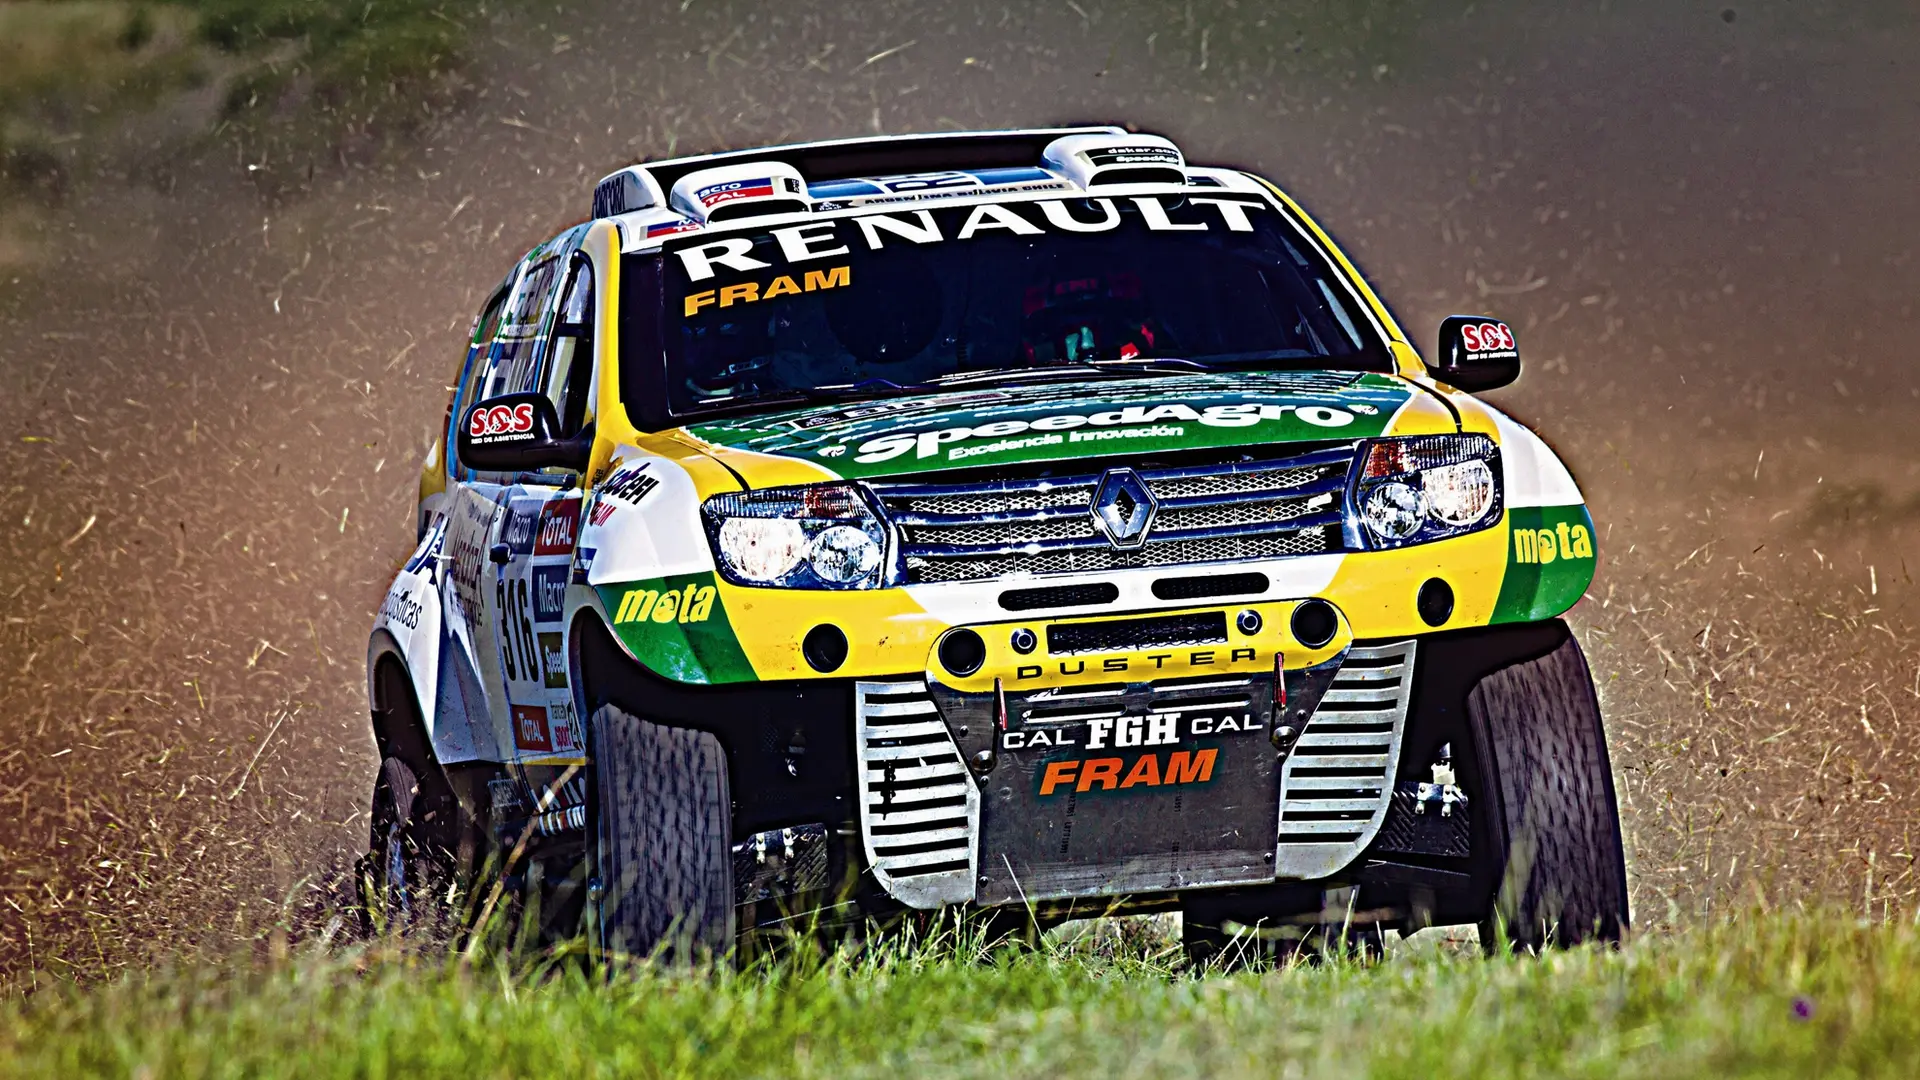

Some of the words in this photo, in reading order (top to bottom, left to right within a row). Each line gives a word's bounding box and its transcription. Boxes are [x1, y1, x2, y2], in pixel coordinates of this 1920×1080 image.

[1022, 183, 1065, 194] CHILE
[673, 195, 1267, 283] RENAULT
[685, 266, 851, 317] FRAM
[494, 433, 535, 443] ASISTENCIA
[948, 432, 1062, 461] Excelencia
[1069, 424, 1185, 445] Innovación
[506, 509, 531, 544] Macro
[542, 509, 572, 546] TOTAL
[1513, 521, 1593, 565] mota
[614, 583, 717, 625] mota
[497, 578, 539, 683] 316
[1017, 647, 1256, 680] DUSTER
[519, 712, 544, 742] TOTAL
[1003, 729, 1075, 750] CAL
[1085, 713, 1182, 750] FGH
[1191, 714, 1264, 735] CAL
[1039, 748, 1219, 796] FRAM
